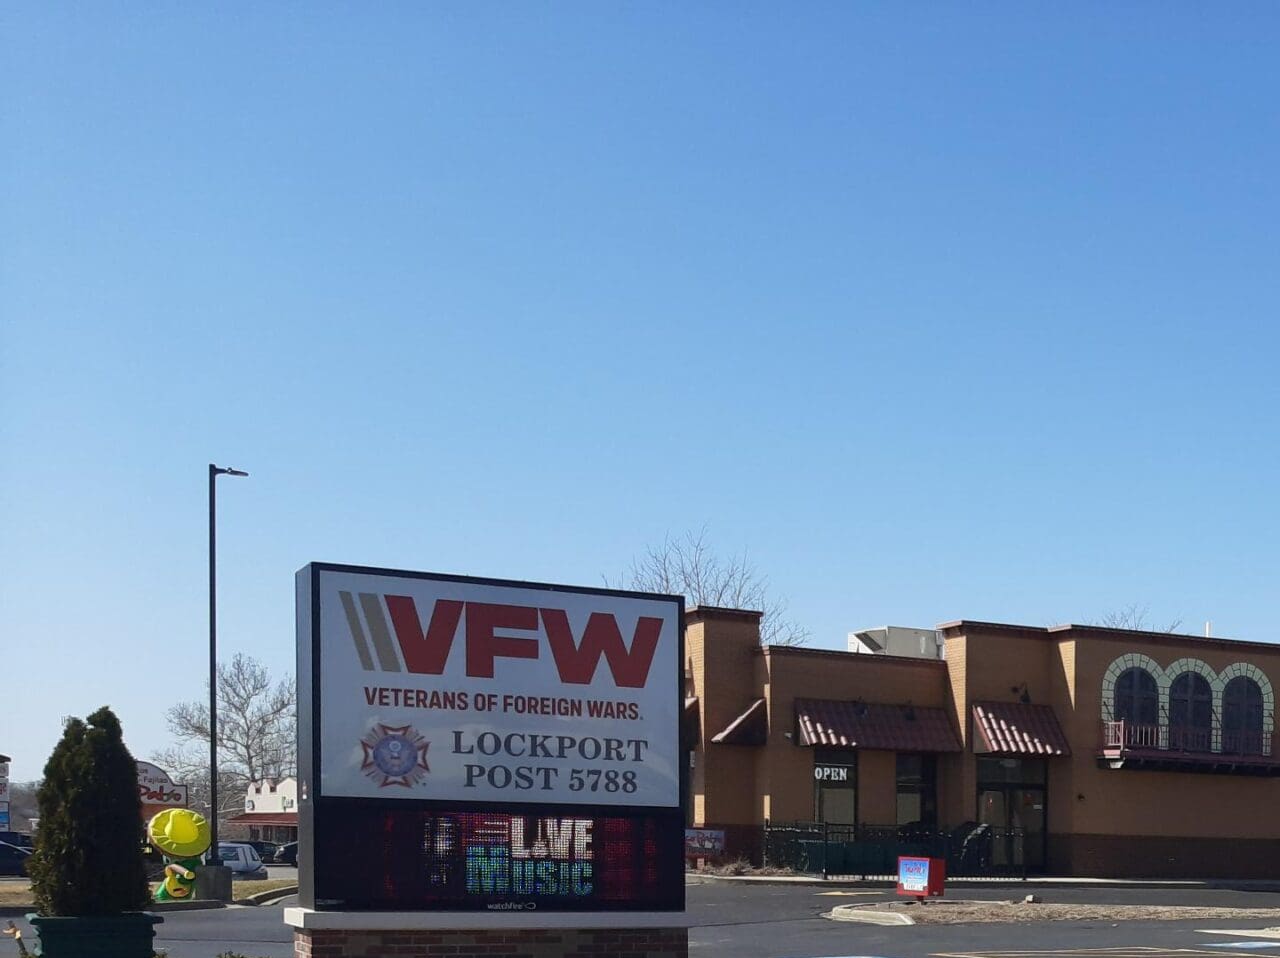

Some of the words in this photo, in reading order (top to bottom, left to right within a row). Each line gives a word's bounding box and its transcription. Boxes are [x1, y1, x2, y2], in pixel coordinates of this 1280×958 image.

[384, 594, 664, 688] VFW
[364, 687, 468, 711] VETERANS
[474, 693, 498, 712] OF
[503, 695, 582, 716] FOREIGN
[452, 730, 648, 762] LOCKPORT
[464, 764, 559, 790] POST
[568, 768, 638, 793] 5788
[814, 767, 848, 780] OPEN
